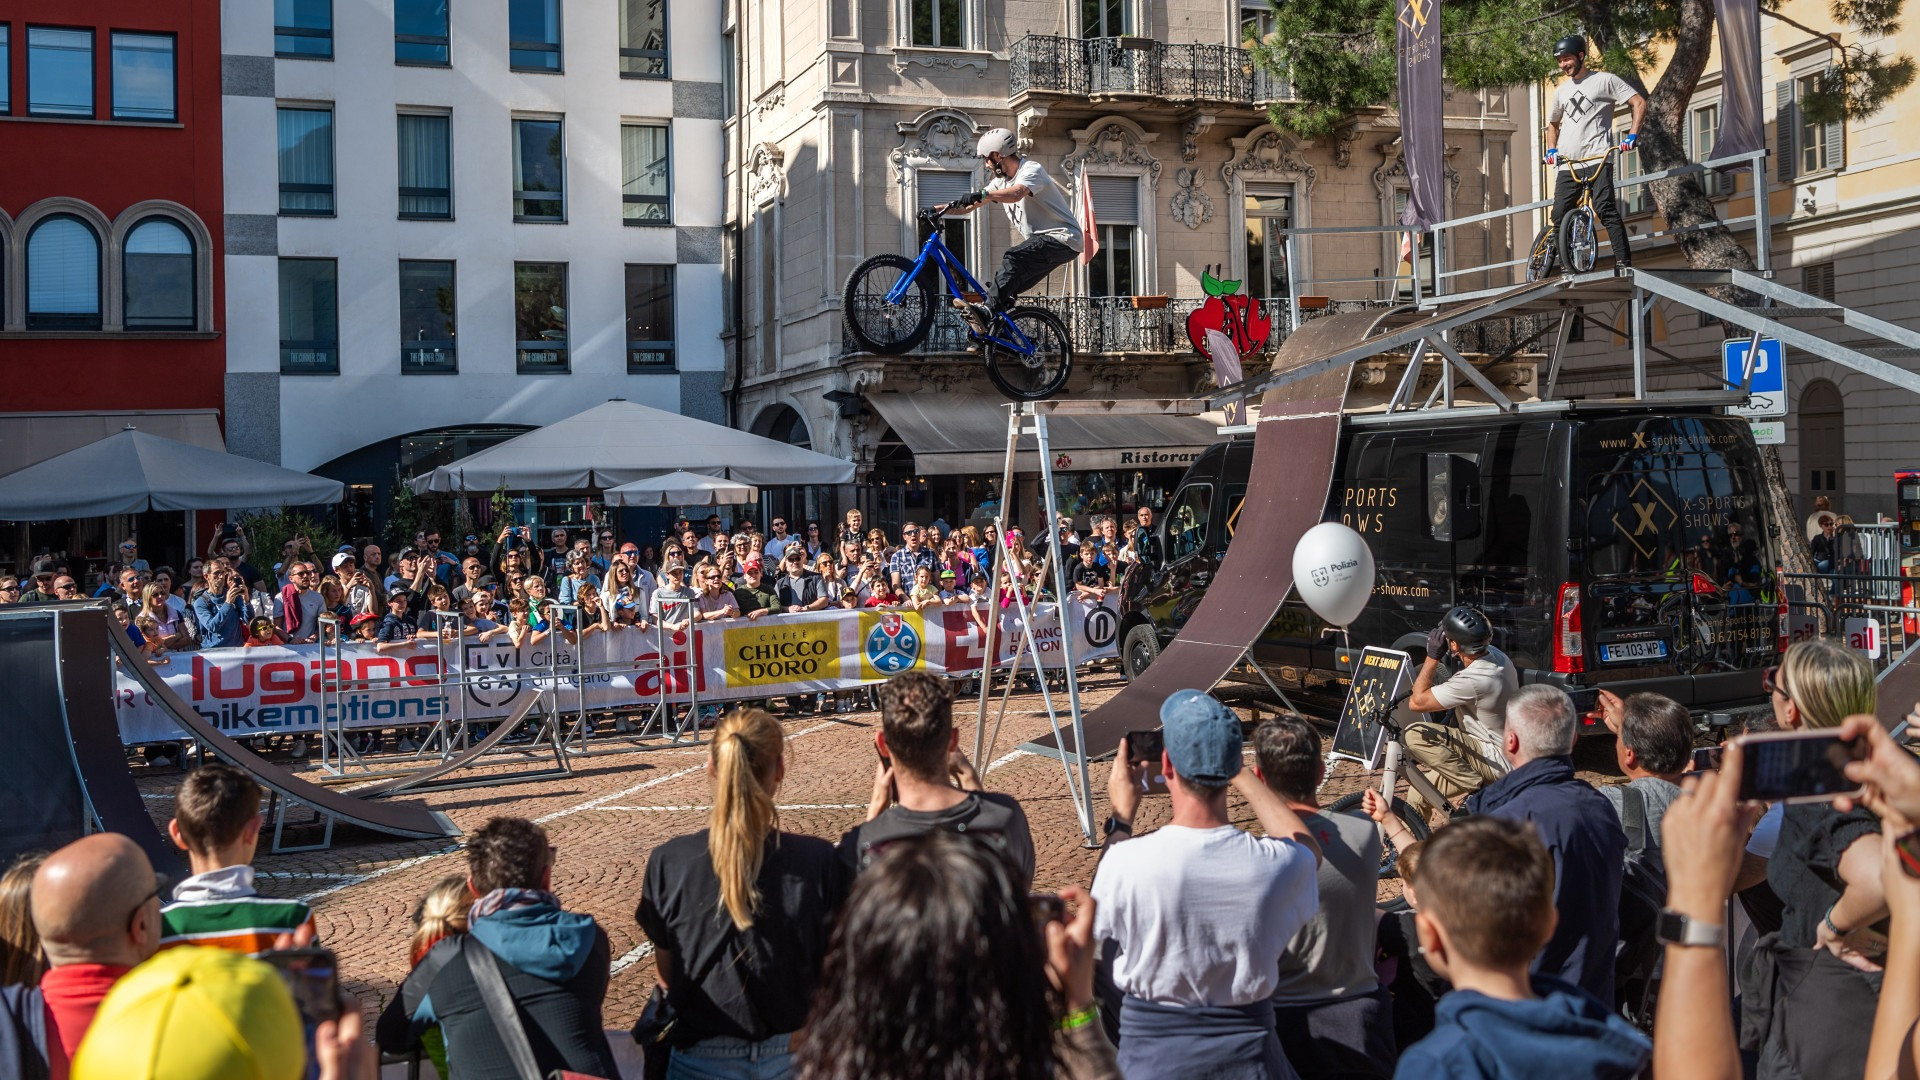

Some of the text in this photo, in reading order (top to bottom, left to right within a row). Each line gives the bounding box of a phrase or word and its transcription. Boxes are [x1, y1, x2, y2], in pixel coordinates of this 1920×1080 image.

[1683, 496, 1746, 511] X-SPORTS
[1684, 513, 1730, 528] SHOWS
[1331, 559, 1358, 572] Polizia
[1725, 615, 1747, 626] Sports
[1748, 613, 1769, 623] Shows
[760, 630, 807, 641] CAFFÈ
[1617, 632, 1656, 640] MASTER
[1718, 631, 1725, 643] 6
[1726, 630, 1736, 642] 21
[1737, 628, 1748, 641] 54
[1850, 626, 1874, 650] ail
[739, 640, 828, 661] CHICCO
[1608, 644, 1659, 658] FE-103-WP
[1746, 645, 1773, 653] RENAULT
[531, 650, 570, 667] Città
[634, 630, 706, 697] ail
[1364, 654, 1400, 671] NEXT SHOW
[749, 658, 818, 679] D'ORO
[192, 655, 447, 705] lugano
[532, 673, 548, 687] di
[192, 695, 450, 730] bikemotions
